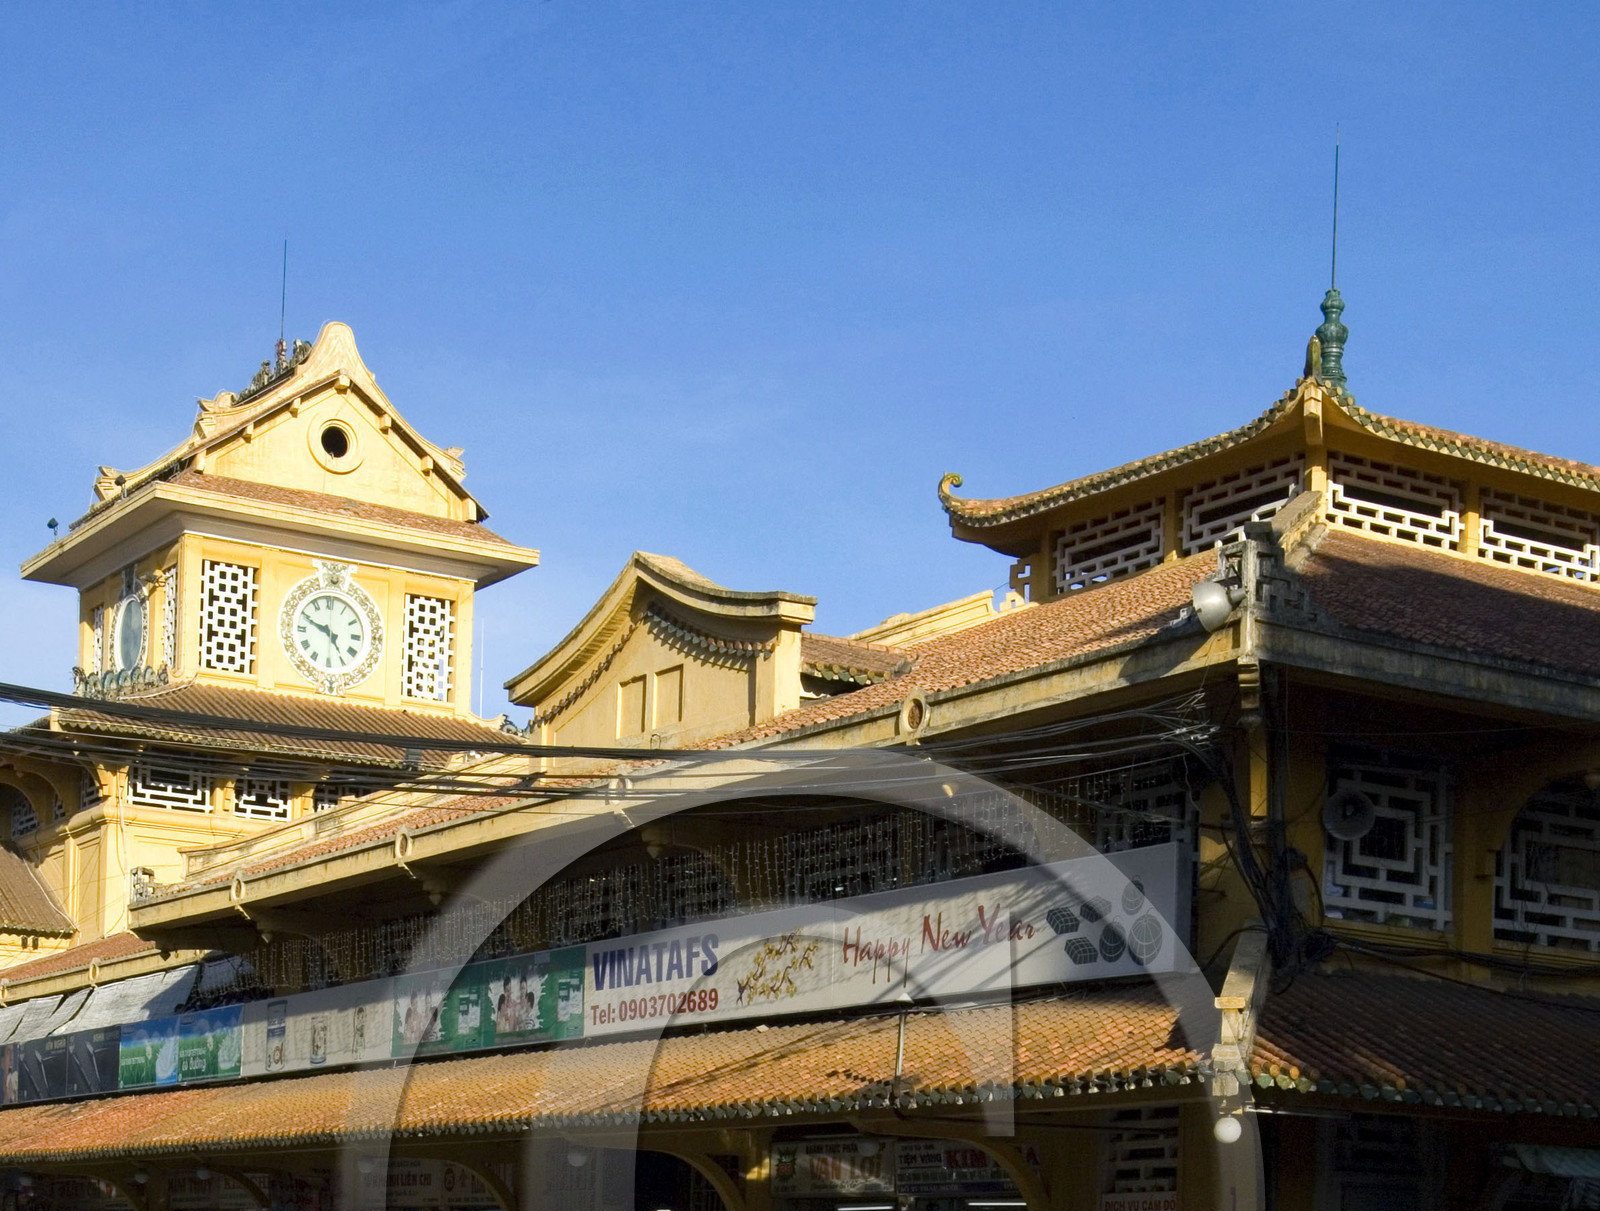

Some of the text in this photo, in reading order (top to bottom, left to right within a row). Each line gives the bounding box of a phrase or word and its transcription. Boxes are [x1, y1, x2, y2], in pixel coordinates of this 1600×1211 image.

[593, 934, 719, 990] VINATAFS
[843, 904, 1037, 985] Happy New Year
[590, 989, 720, 1026] Tel: 0903702689
